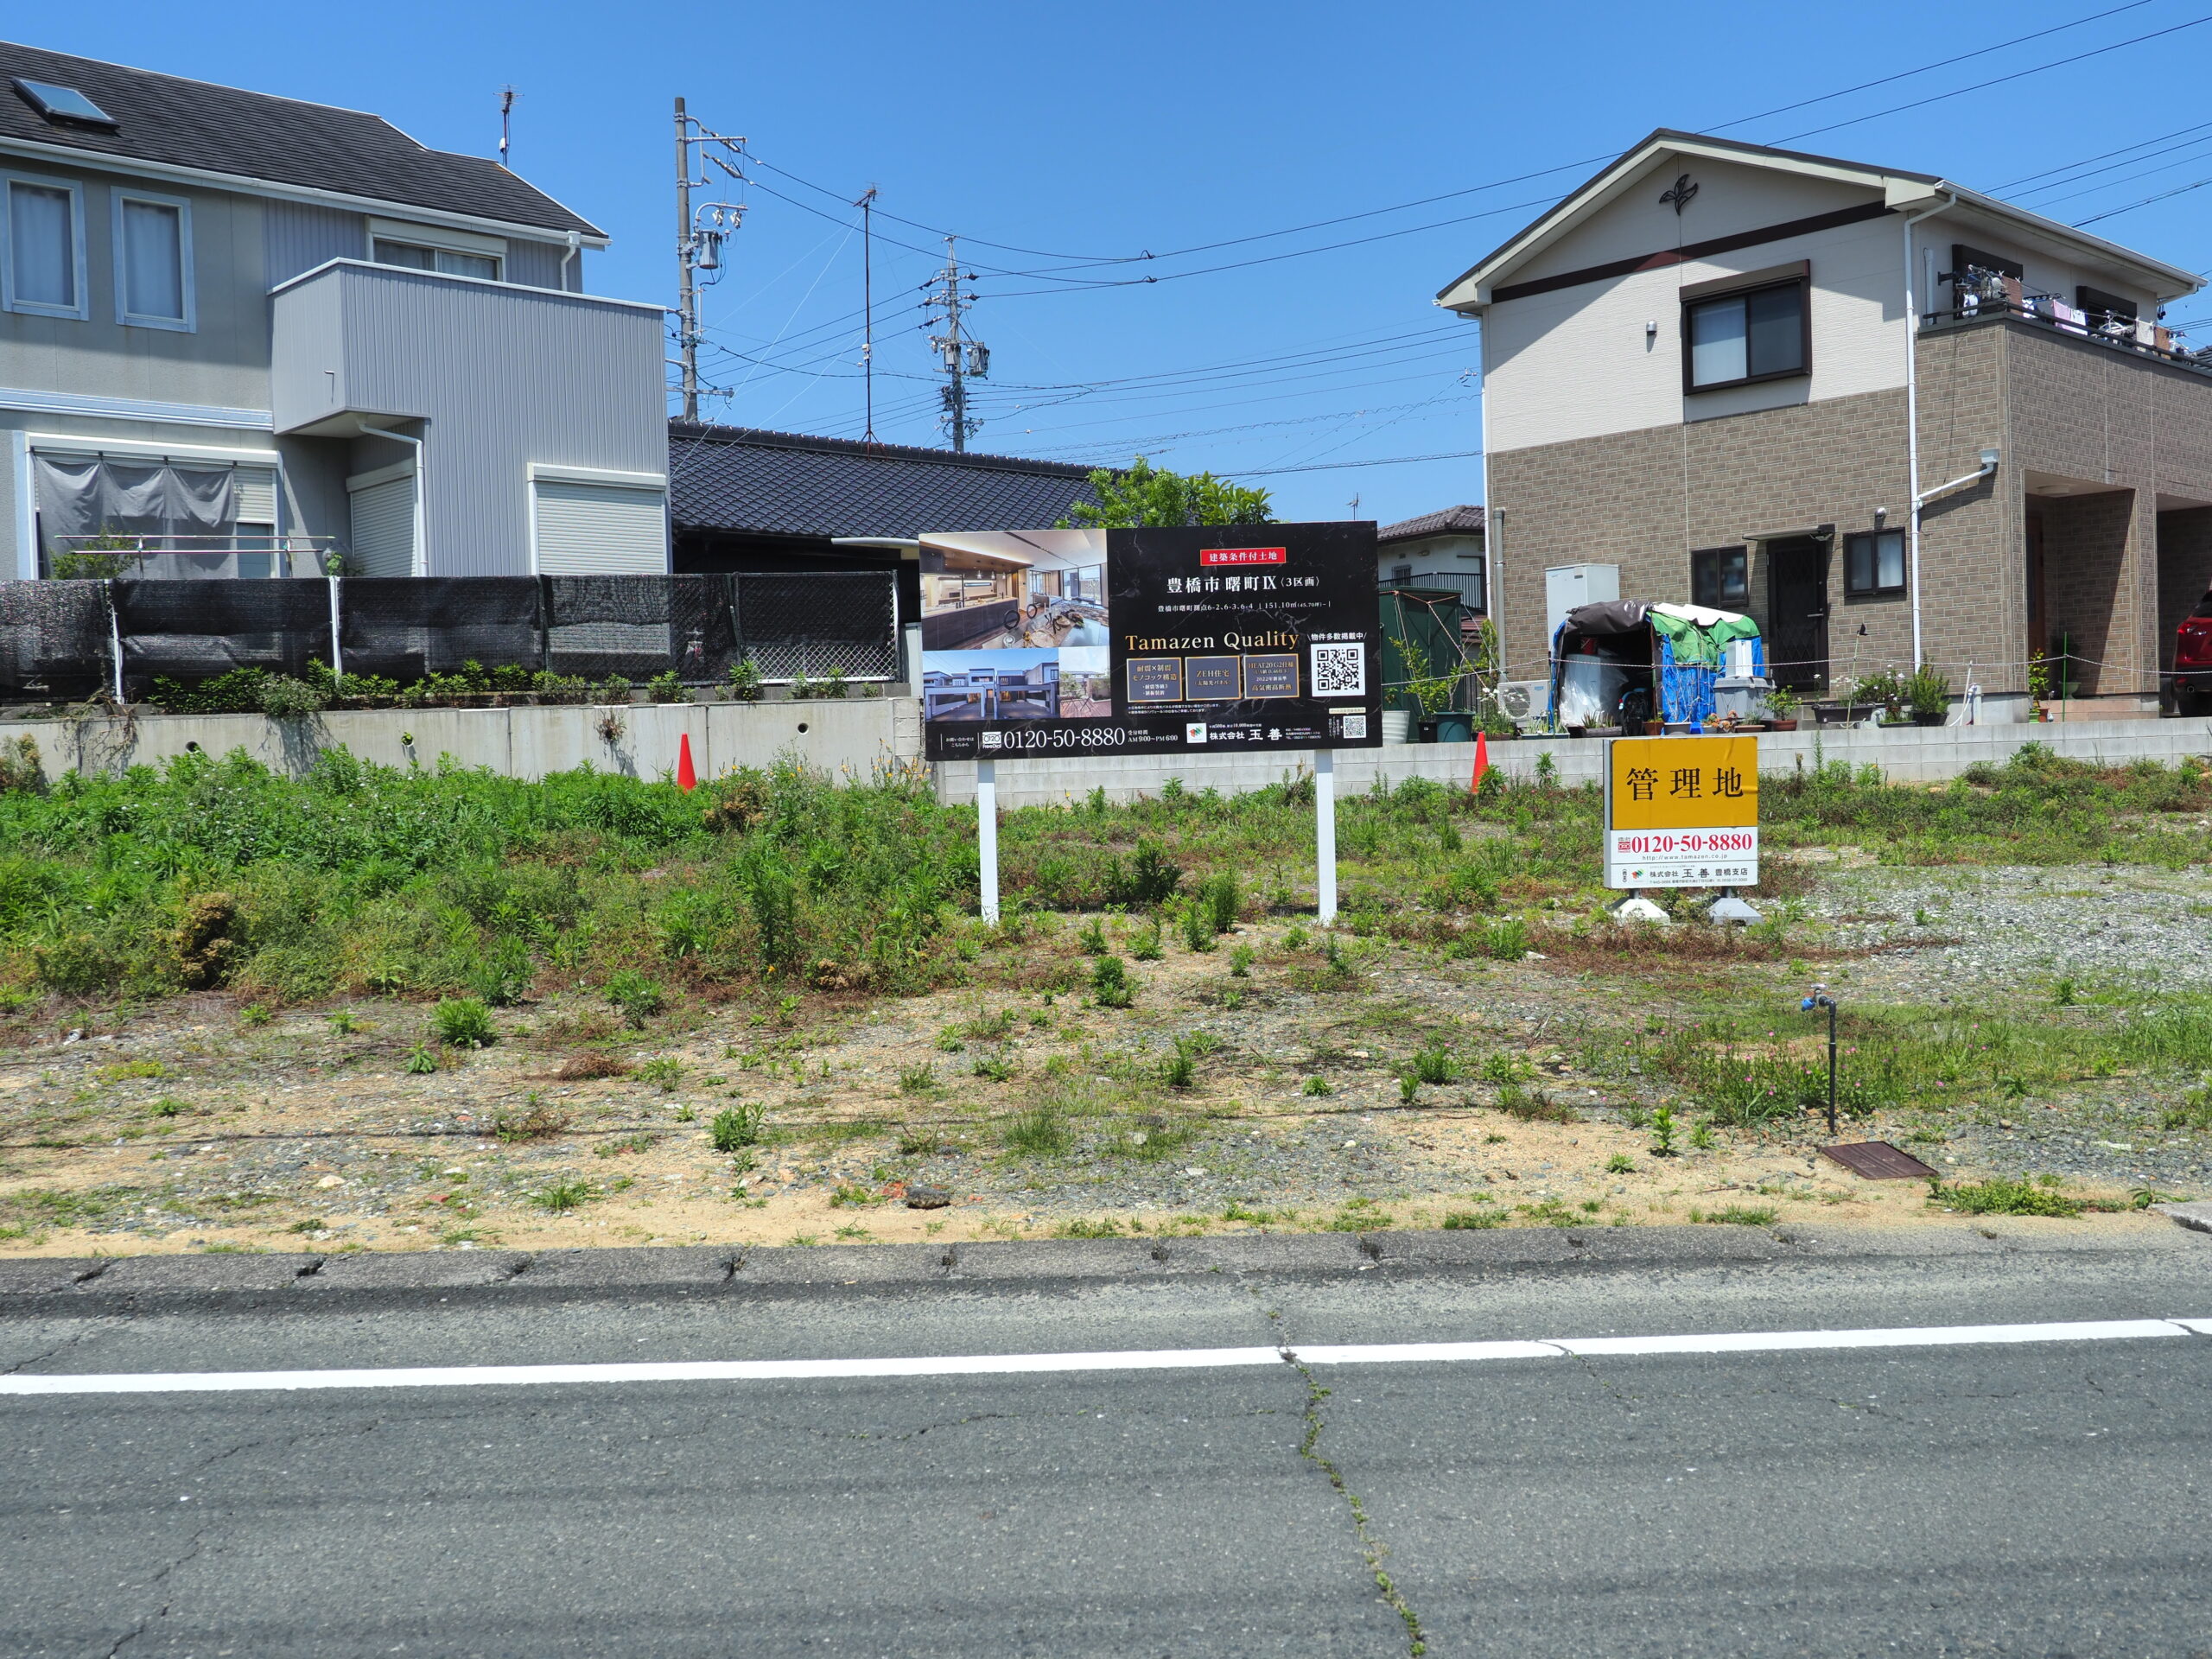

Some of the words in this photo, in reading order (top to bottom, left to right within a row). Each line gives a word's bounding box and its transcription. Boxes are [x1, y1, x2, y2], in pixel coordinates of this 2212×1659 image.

[1209, 550, 1278, 563] 建築条件付土地
[1125, 634, 1215, 650] Tamazen
[1224, 630, 1299, 650] Quality
[1310, 632, 1364, 641] 物件多数掲載中
[1196, 669, 1230, 677] ZEH住宅
[1003, 728, 1126, 749] 0120-50-8880
[1209, 730, 1245, 741] 株式会社
[1626, 766, 1744, 801] 管理地
[1631, 834, 1752, 853] 0120-50-8880
[1649, 869, 1679, 878] 株式会社
[1715, 867, 1749, 876] 豊橋支店
